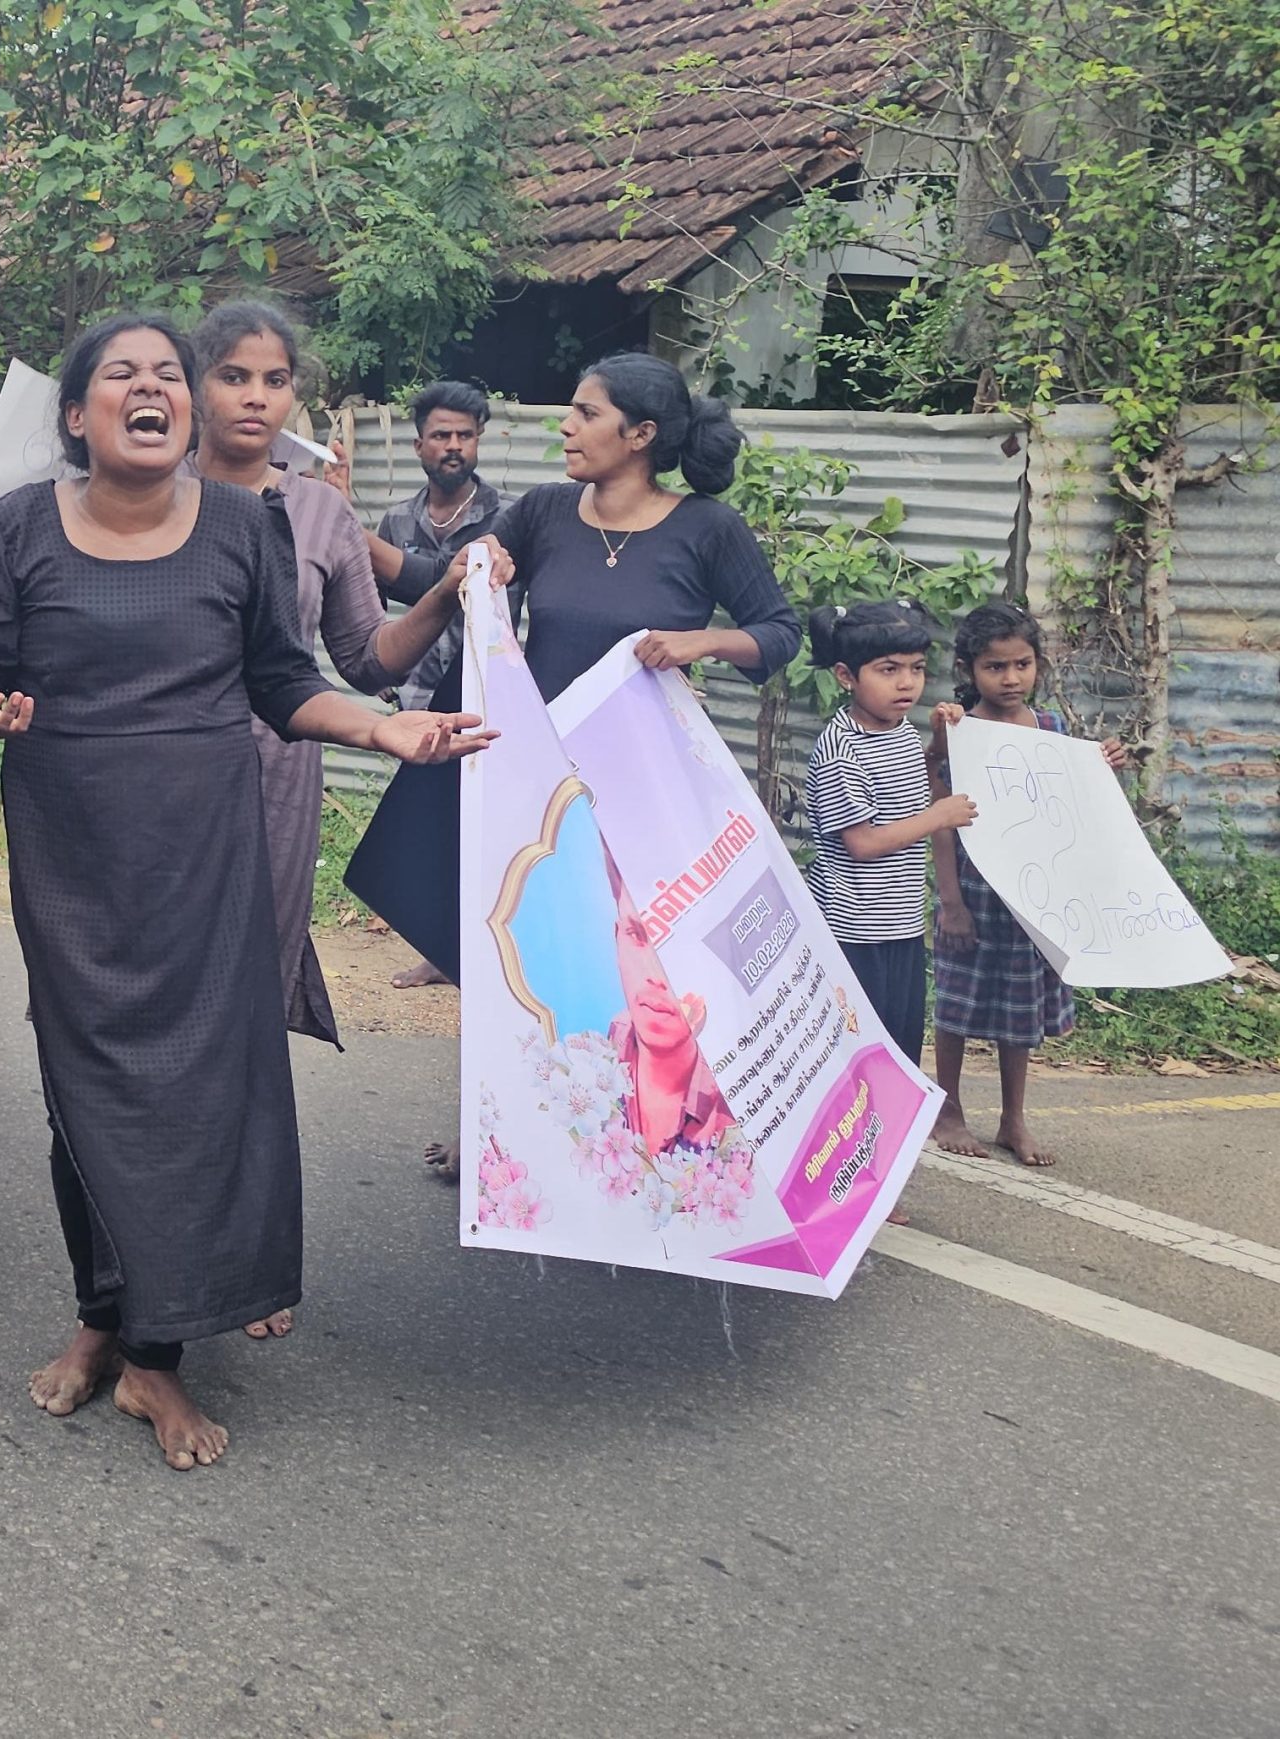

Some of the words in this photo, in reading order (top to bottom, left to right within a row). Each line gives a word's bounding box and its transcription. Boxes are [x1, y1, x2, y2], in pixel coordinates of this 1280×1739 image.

[642, 810, 756, 943] ருள்பயாஸ்
[742, 912, 795, 986] 10.02.2026
[725, 1029, 785, 1101] னைவுகளுடன்
